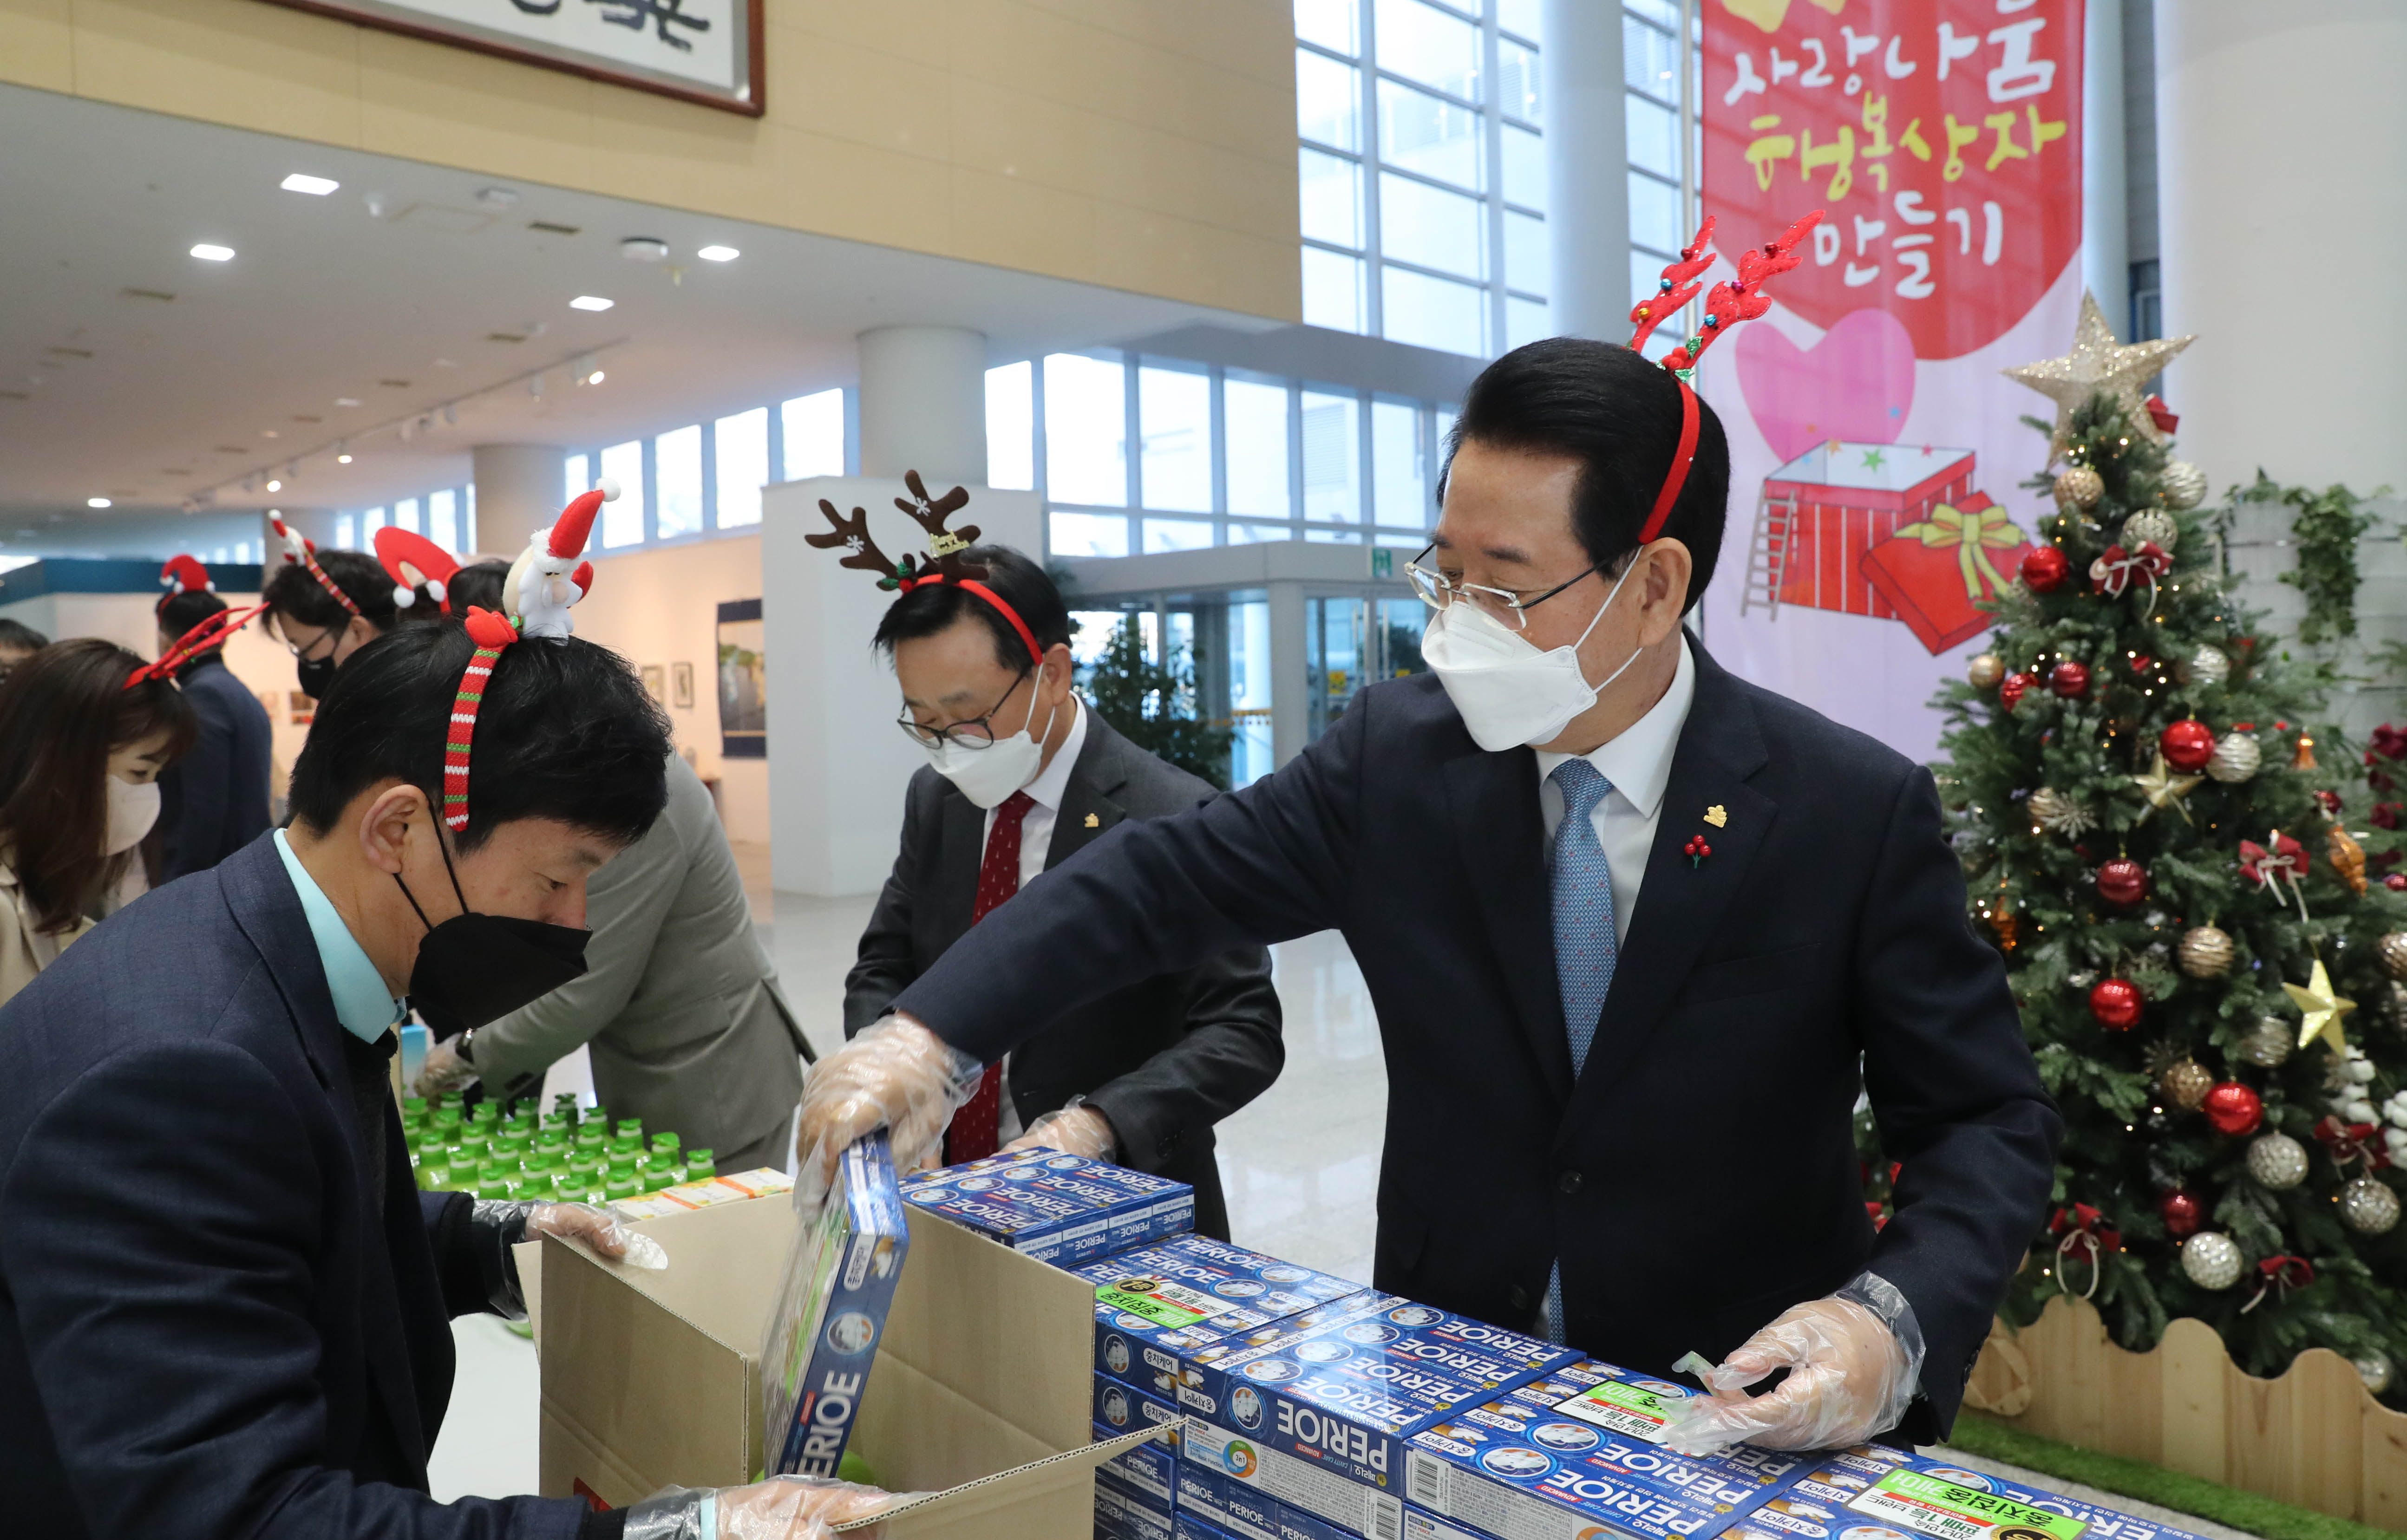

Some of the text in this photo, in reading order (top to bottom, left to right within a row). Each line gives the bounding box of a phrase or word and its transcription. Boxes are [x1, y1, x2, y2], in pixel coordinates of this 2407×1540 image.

[1745, 91, 2066, 201] 행복상자
[1813, 190, 2002, 299] 만들기
[1081, 1165, 1172, 1191] PERIOE
[1038, 1176, 1130, 1203] PERIOE
[999, 1186, 1086, 1215] PERIOE
[945, 1199, 1037, 1228] PERIOE
[1163, 1208, 1191, 1224] PERIOE
[1120, 1221, 1149, 1237] PERIOE
[1074, 1233, 1106, 1250] PERIOE
[1174, 1240, 1271, 1270] PERIOE
[1128, 1251, 1226, 1283] PERIOE
[1436, 1320, 1557, 1362] PERIOE
[1146, 1351, 1173, 1370] 충치케어
[1218, 1351, 1260, 1366] 충치케어
[1387, 1349, 1416, 1360] ADVANCED
[1392, 1338, 1519, 1382] PERIOE
[1503, 1351, 1530, 1363] 페리오
[1354, 1357, 1474, 1403] PERIOE
[1458, 1371, 1485, 1383] 페리오
[1562, 1370, 1599, 1385] 치케어
[1184, 1390, 1213, 1411] 충치케어
[1289, 1376, 1422, 1426] PERIOE
[1410, 1392, 1436, 1404] 페리오
[1519, 1390, 1552, 1406] 치케어
[1597, 1383, 1643, 1403] 케어
[1145, 1405, 1171, 1422] 충치케어
[1472, 1412, 1521, 1430] 충치케어
[1570, 1400, 1661, 1432] 판매 1등 브랜드
[1621, 1408, 1654, 1421] 베이킹소다
[797, 1370, 861, 1478] ERIOE
[1603, 1419, 1650, 1437] 20년 연속
[1277, 1399, 1388, 1473] PERIOE
[1420, 1435, 1472, 1455] 충치케어
[1236, 1454, 1245, 1463] 3in1
[1297, 1443, 1320, 1457] ADVANCED
[1354, 1464, 1376, 1481] 페리오
[1590, 1458, 1628, 1474] ADVANCED
[1593, 1442, 1755, 1505] PERIOE
[1727, 1462, 1761, 1478] 페리오
[1844, 1456, 1888, 1472] 치케어
[1181, 1478, 1213, 1502] PERIOE
[1601, 1475, 1635, 1491] 충치케어
[1803, 1484, 1849, 1501] 치케어
[1890, 1472, 1947, 1496] 케어
[1540, 1485, 1579, 1502] ADVANCED
[1543, 1469, 1708, 1535] PERIOE
[1681, 1488, 1717, 1507] 페리오
[1230, 1501, 1264, 1526] PERIOE
[1689, 1507, 1717, 1520] 알칼리
[1865, 1494, 1981, 1535] 판매 1등 브랜드
[1926, 1505, 1968, 1520] 베이킹소다
[1942, 1488, 2053, 1527] 충치집중
[1631, 1518, 1670, 1538] 페리오
[1760, 1512, 1821, 1535] 충치케어
[1914, 1520, 1972, 1540] 20년 연속
